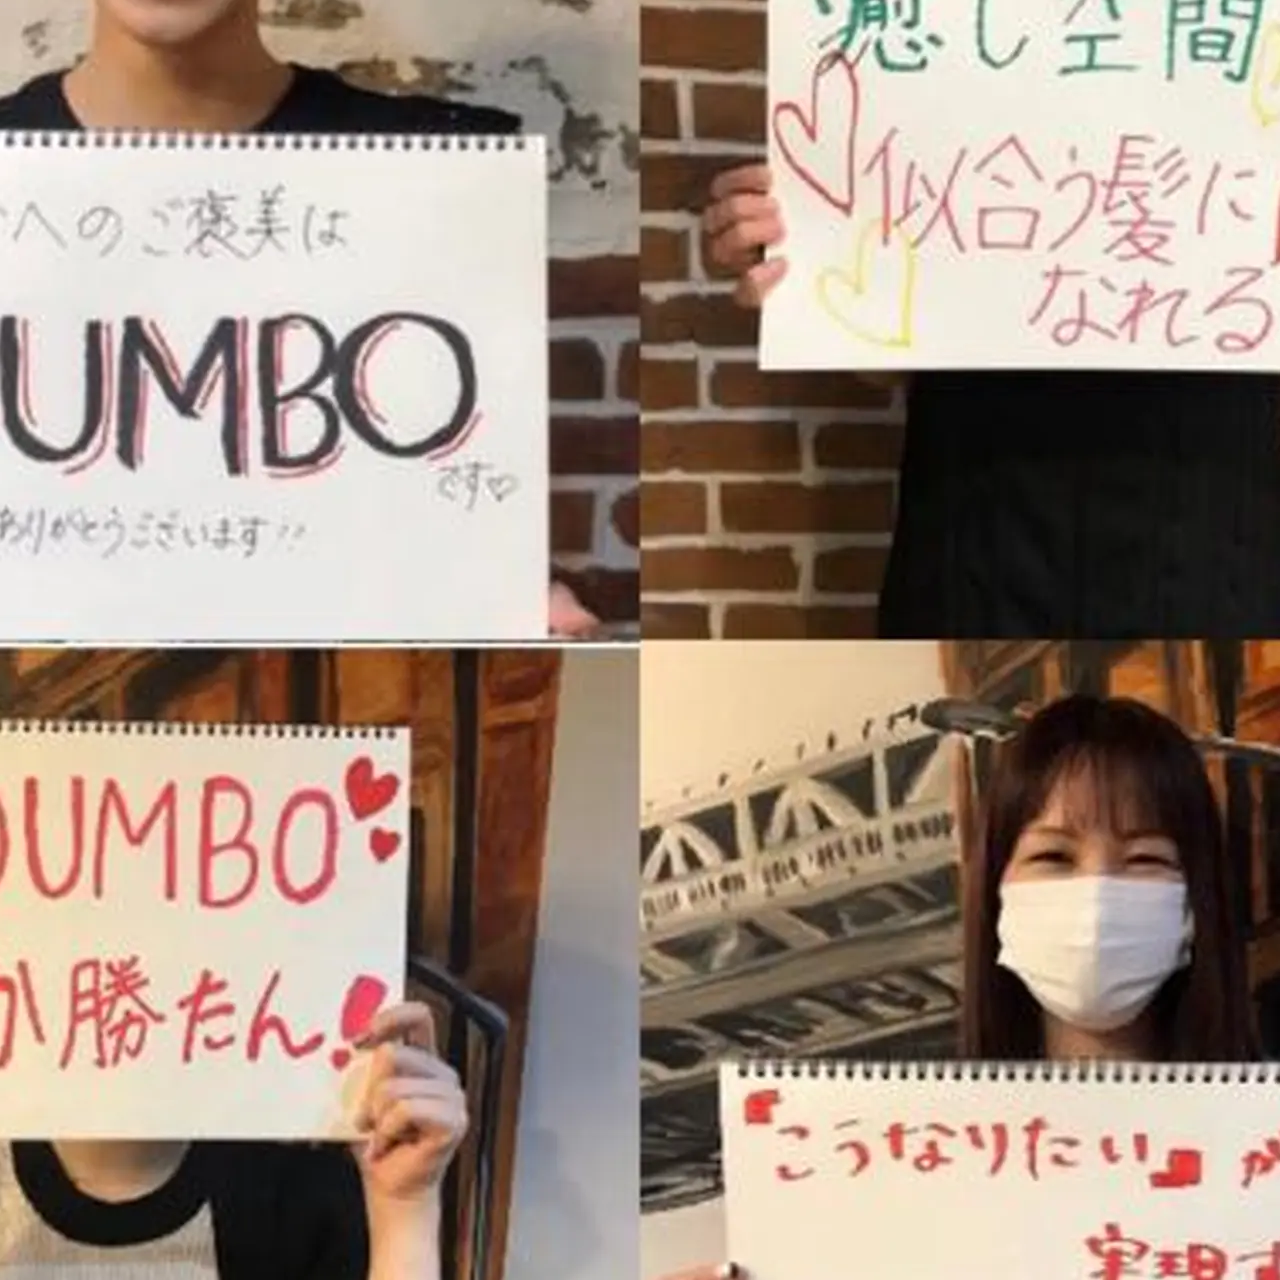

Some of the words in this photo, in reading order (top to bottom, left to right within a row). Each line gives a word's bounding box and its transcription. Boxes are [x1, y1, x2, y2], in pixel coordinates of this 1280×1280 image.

[863, 127, 1257, 266] 似合う髪に
[1027, 264, 1275, 354] なれる
